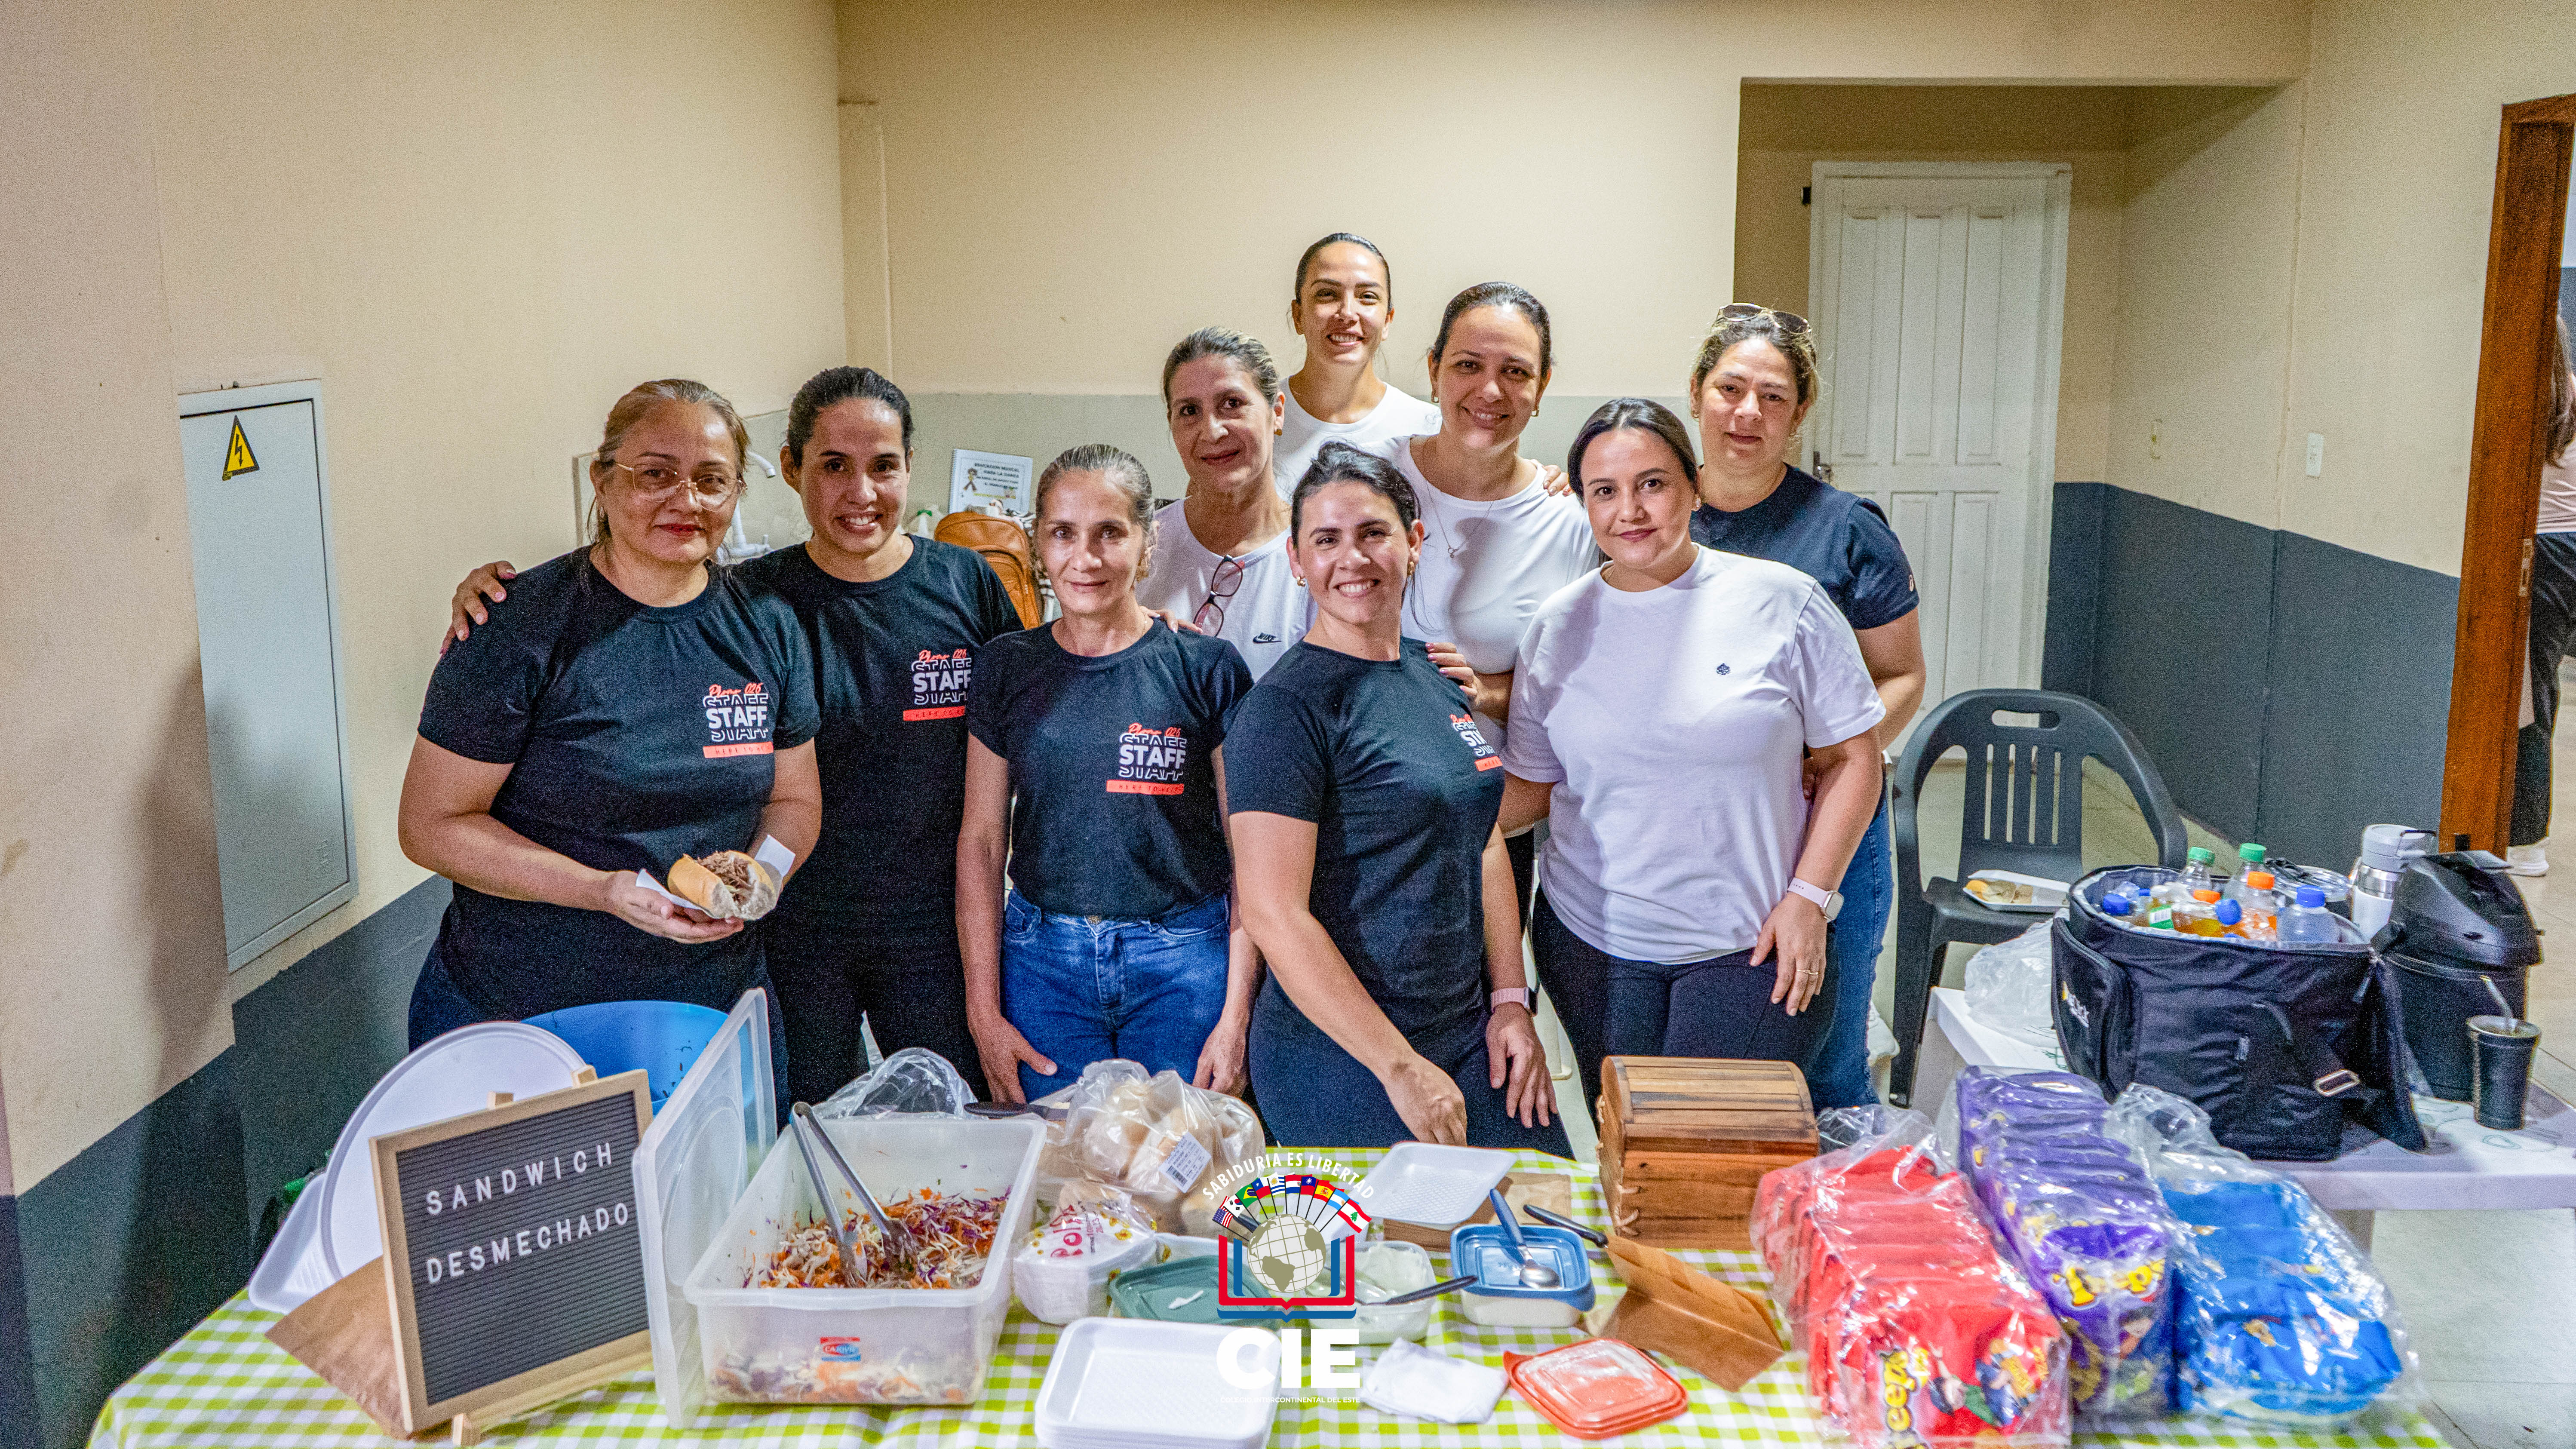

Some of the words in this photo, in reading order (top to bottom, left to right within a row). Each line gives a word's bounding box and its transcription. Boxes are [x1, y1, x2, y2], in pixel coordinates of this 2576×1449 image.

[1258, 632, 1276, 641] NIKE
[913, 669, 972, 693] STAFF
[706, 706, 768, 729] STAFF
[1119, 744, 1186, 769] STAFF
[427, 1142, 612, 1216] SANDWICH
[427, 1203, 629, 1283] DESMECHADO
